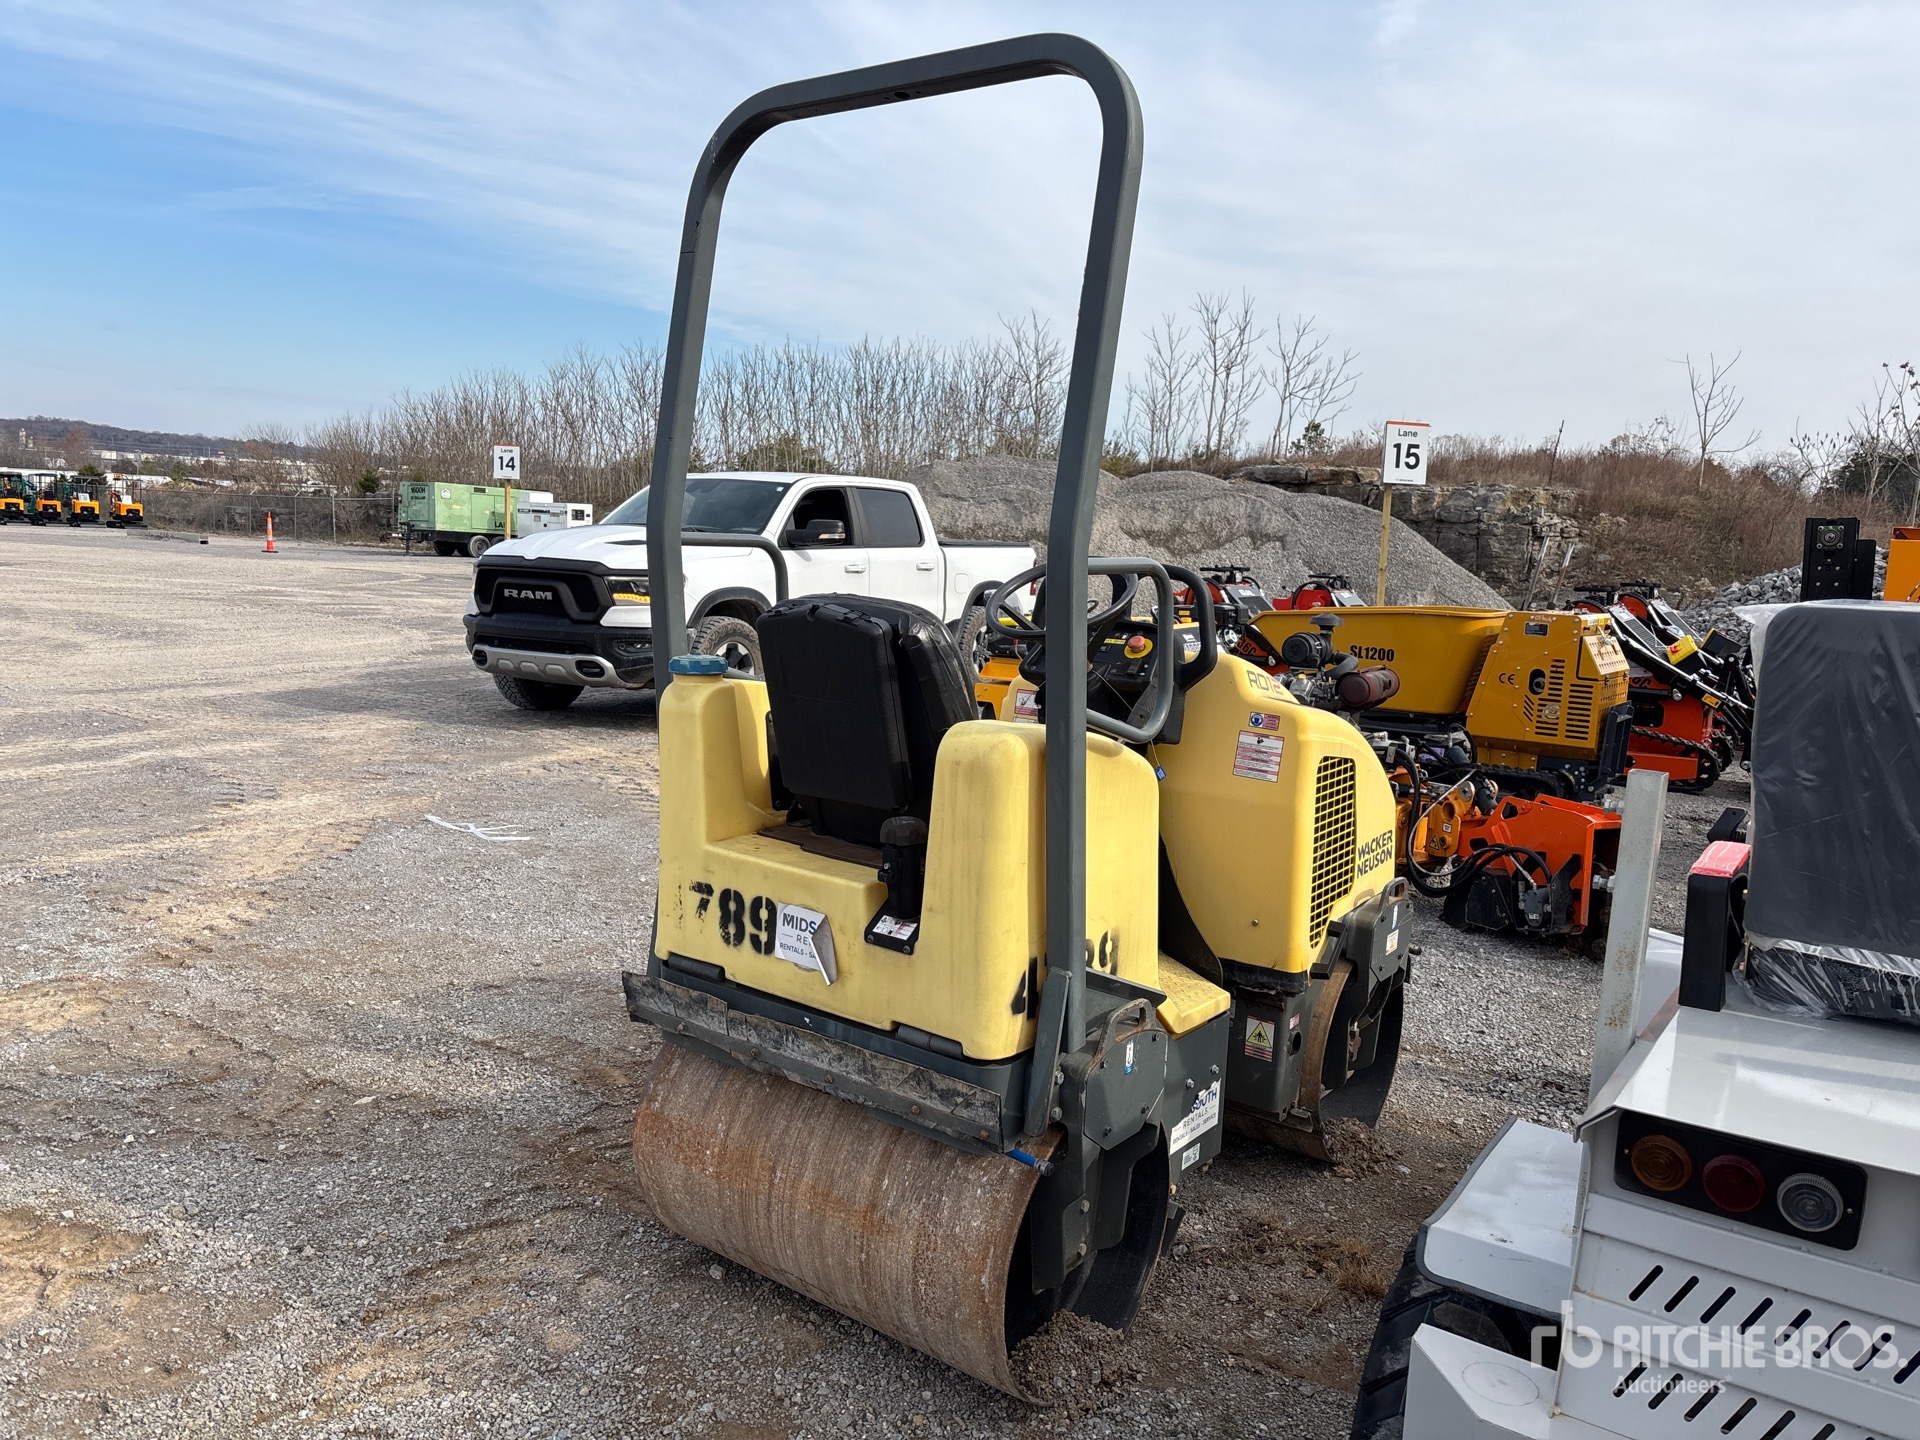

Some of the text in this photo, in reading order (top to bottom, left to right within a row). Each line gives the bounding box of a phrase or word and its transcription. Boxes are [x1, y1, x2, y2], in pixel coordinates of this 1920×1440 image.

[1397, 428, 1418, 438] Lane
[498, 455, 516, 471] 14
[1392, 442, 1421, 470] 15
[503, 588, 553, 600] RAM
[1350, 645, 1395, 662] SL1200
[1357, 829, 1393, 862] WACKER
[1356, 844, 1393, 880] NEUSON
[782, 912, 818, 935] MIDS
[779, 942, 805, 956] RENTALS
[1182, 1107, 1209, 1129] RENTALS
